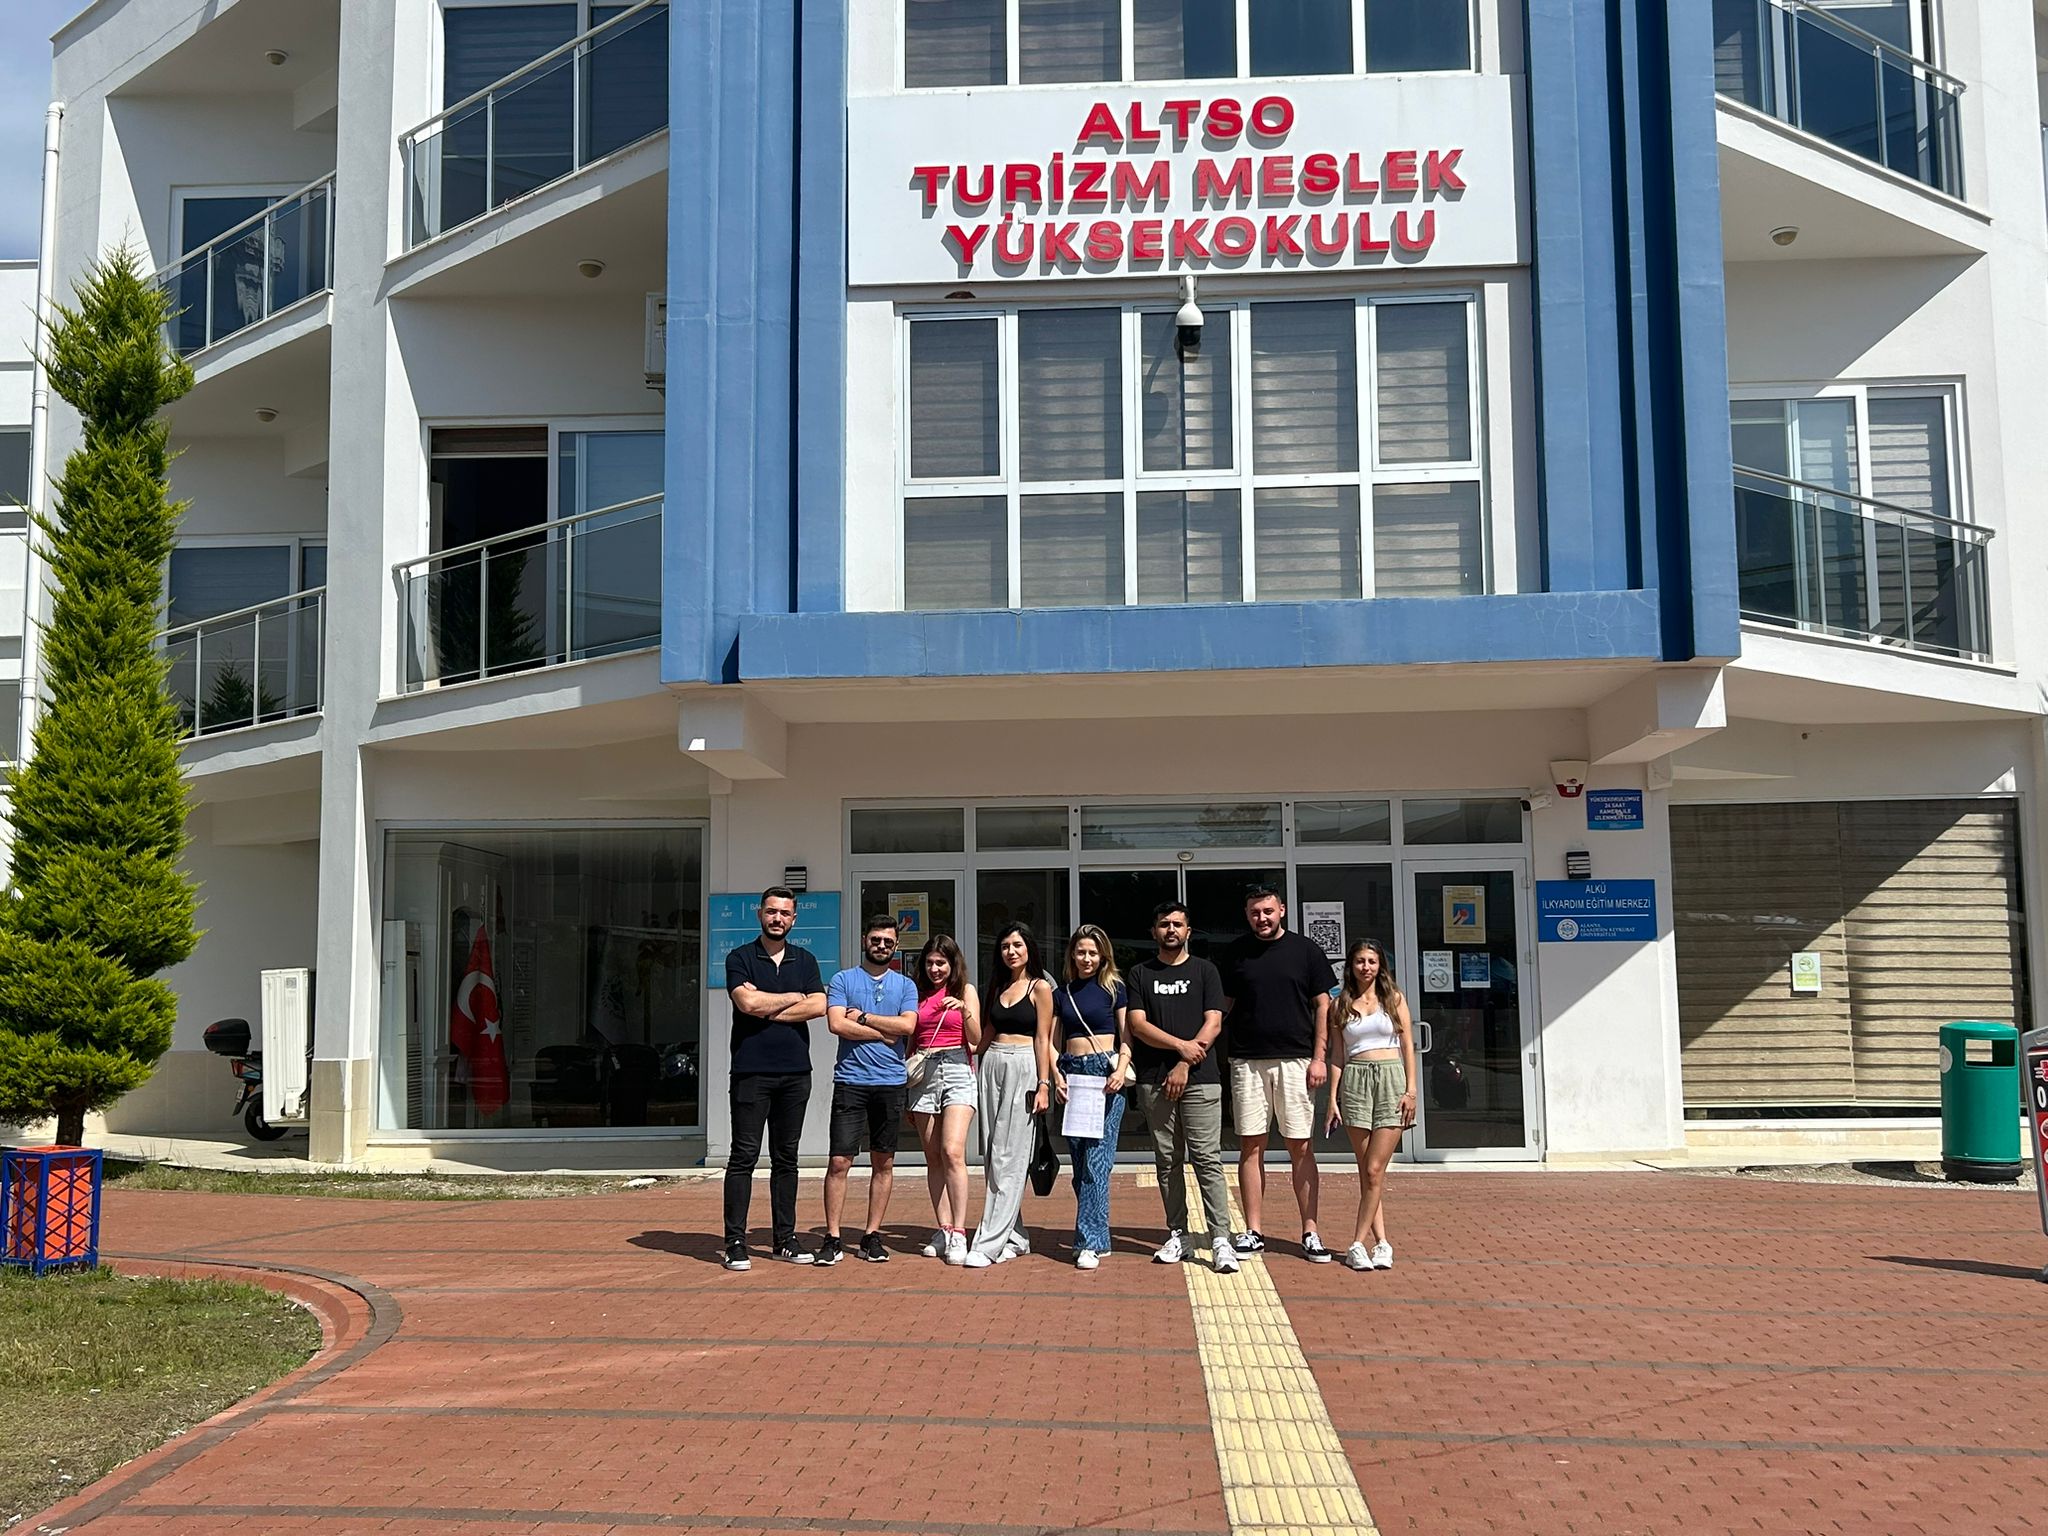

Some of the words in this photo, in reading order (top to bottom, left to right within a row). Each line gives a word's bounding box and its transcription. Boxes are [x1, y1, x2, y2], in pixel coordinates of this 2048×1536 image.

[1078, 96, 1295, 143] ALTSO
[914, 152, 1171, 206] TURİZM
[1197, 149, 1466, 198] MESLEK
[947, 210, 1436, 265] YÜKSEKOKULU
[1542, 897, 1585, 909] İLKYARDIM
[1586, 896, 1614, 909] EĞİTİM
[1615, 896, 1651, 908] MERKEZİ
[1585, 882, 1607, 894] ALKÜ
